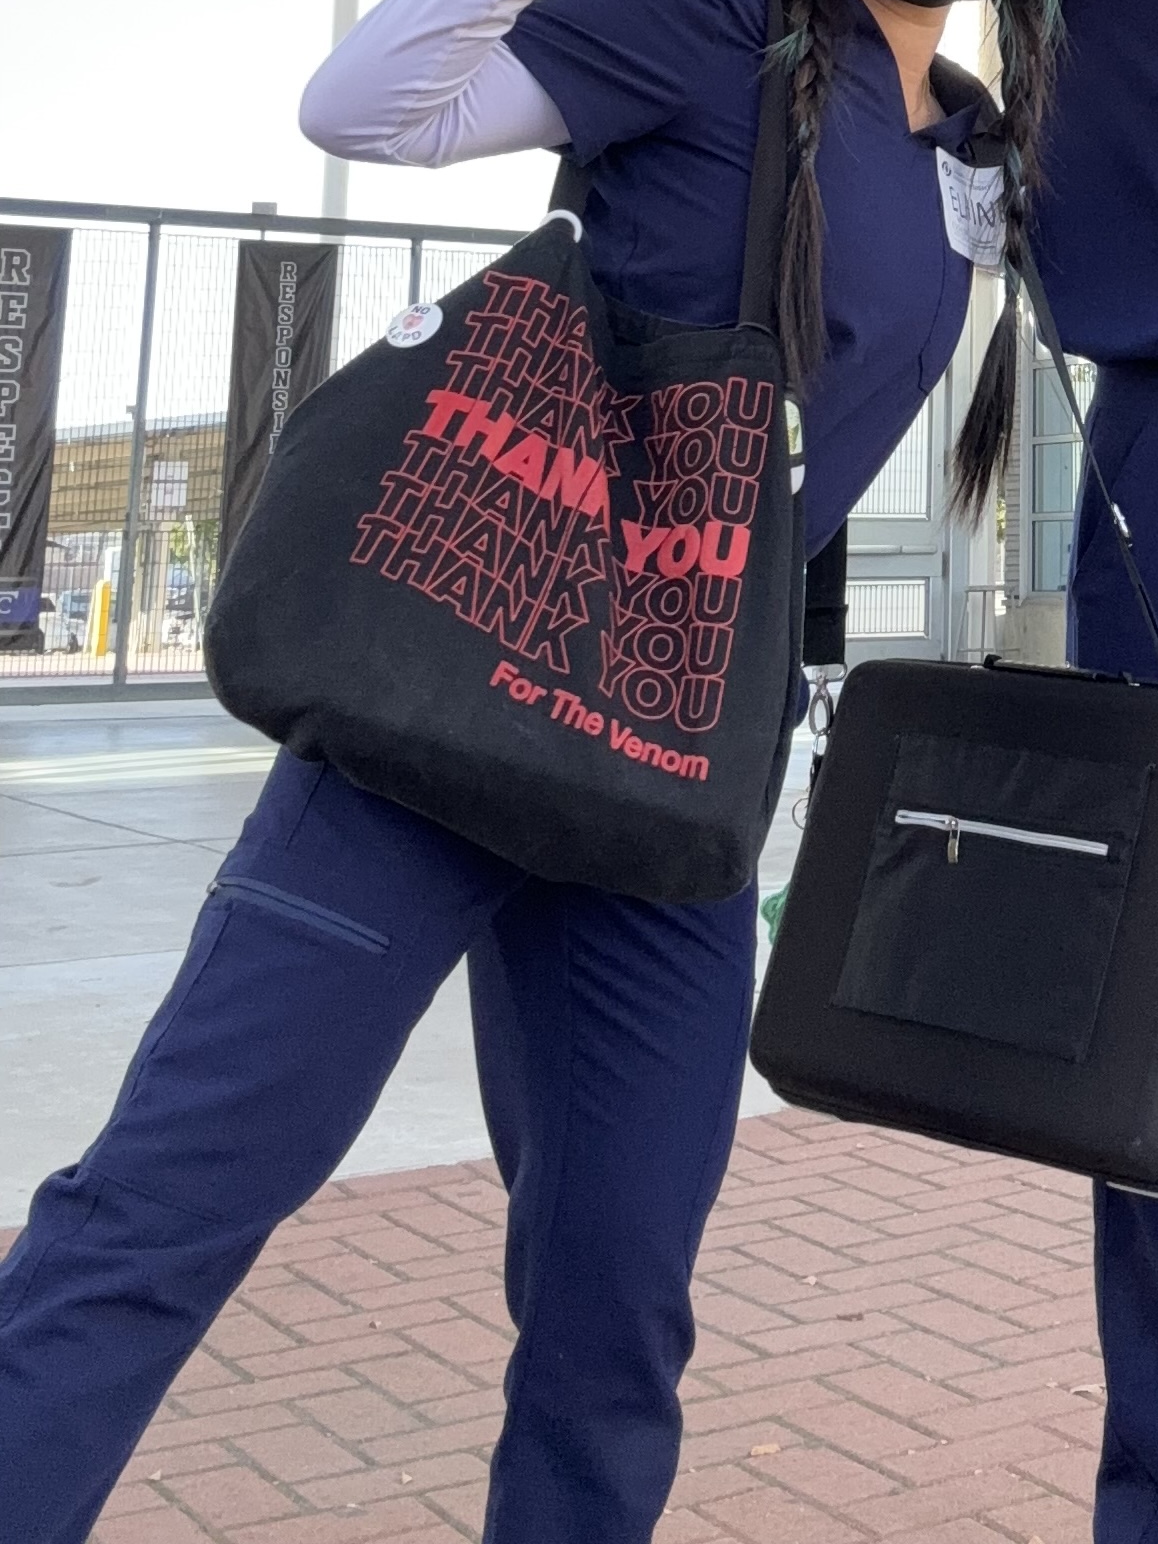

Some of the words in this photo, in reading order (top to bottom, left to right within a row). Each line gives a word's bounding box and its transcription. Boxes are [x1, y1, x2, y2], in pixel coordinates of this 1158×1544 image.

[411, 305, 431, 315] NO
[651, 376, 774, 435] YOU
[644, 423, 768, 485] YOU
[399, 429, 607, 581] THANK
[611, 555, 743, 626] YOU
[633, 471, 760, 528] YOU
[376, 470, 590, 624] THANK
[608, 590, 734, 677] YOU
[621, 519, 751, 577] YOU
[350, 513, 570, 675] THANK
[598, 629, 726, 733] YOU
[489, 659, 548, 705] For
[550, 688, 605, 736] The
[609, 718, 710, 782] Venom
